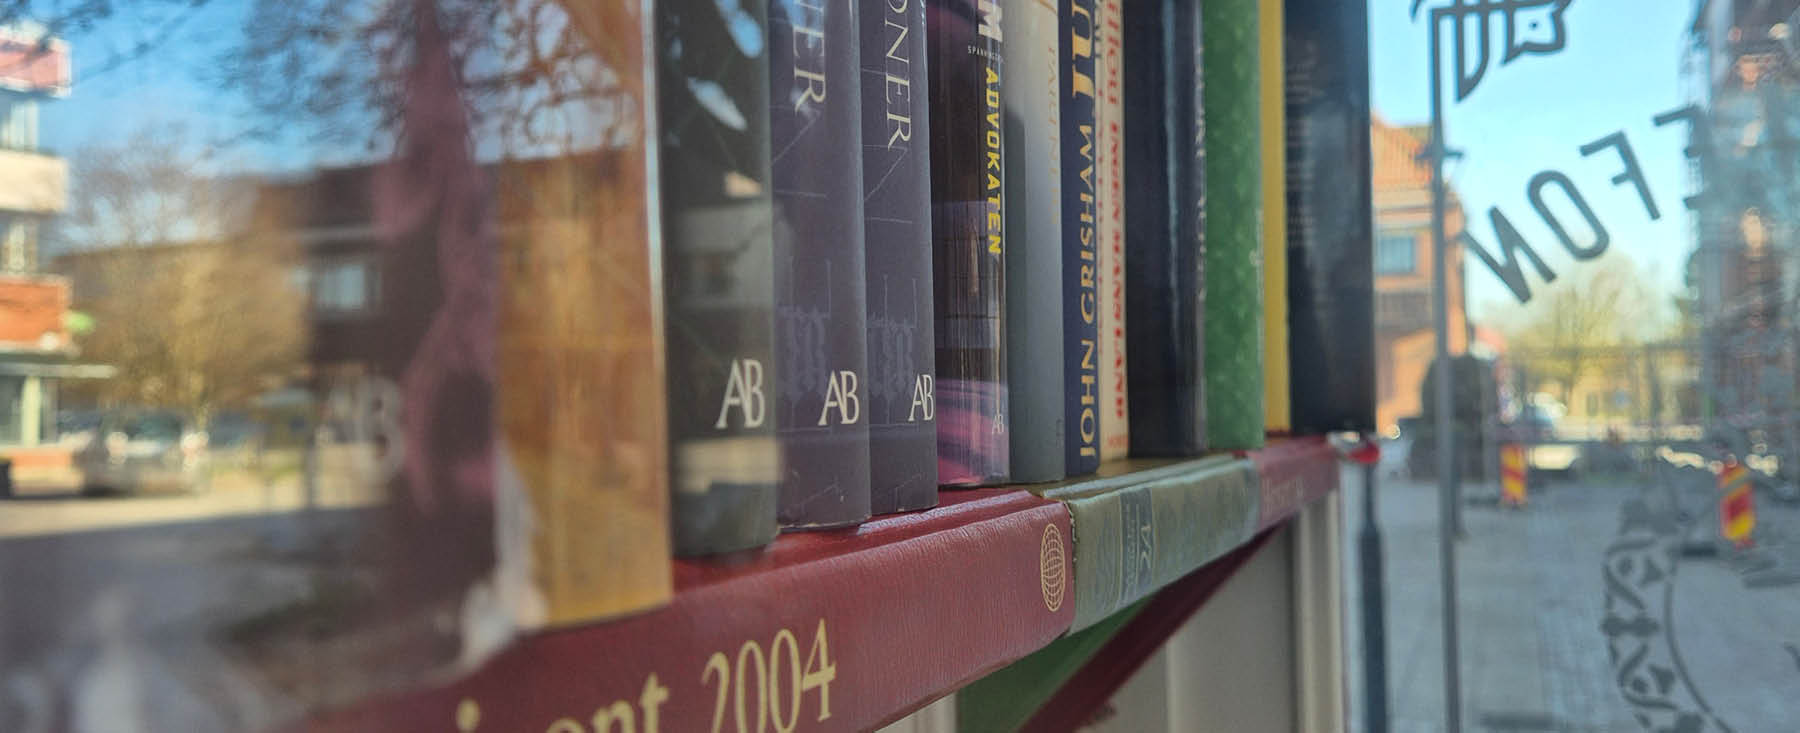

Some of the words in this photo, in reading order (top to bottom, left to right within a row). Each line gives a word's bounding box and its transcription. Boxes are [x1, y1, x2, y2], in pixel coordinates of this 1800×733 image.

[793, 0, 827, 118] ER
[984, 66, 1003, 256] ADVOKATEN
[1079, 124, 1096, 325] GRISHAM
[715, 358, 766, 430] AB
[817, 370, 860, 426] AB
[907, 374, 934, 422] AB
[1079, 338, 1096, 458] JOHN
[700, 617, 838, 733] 2004
